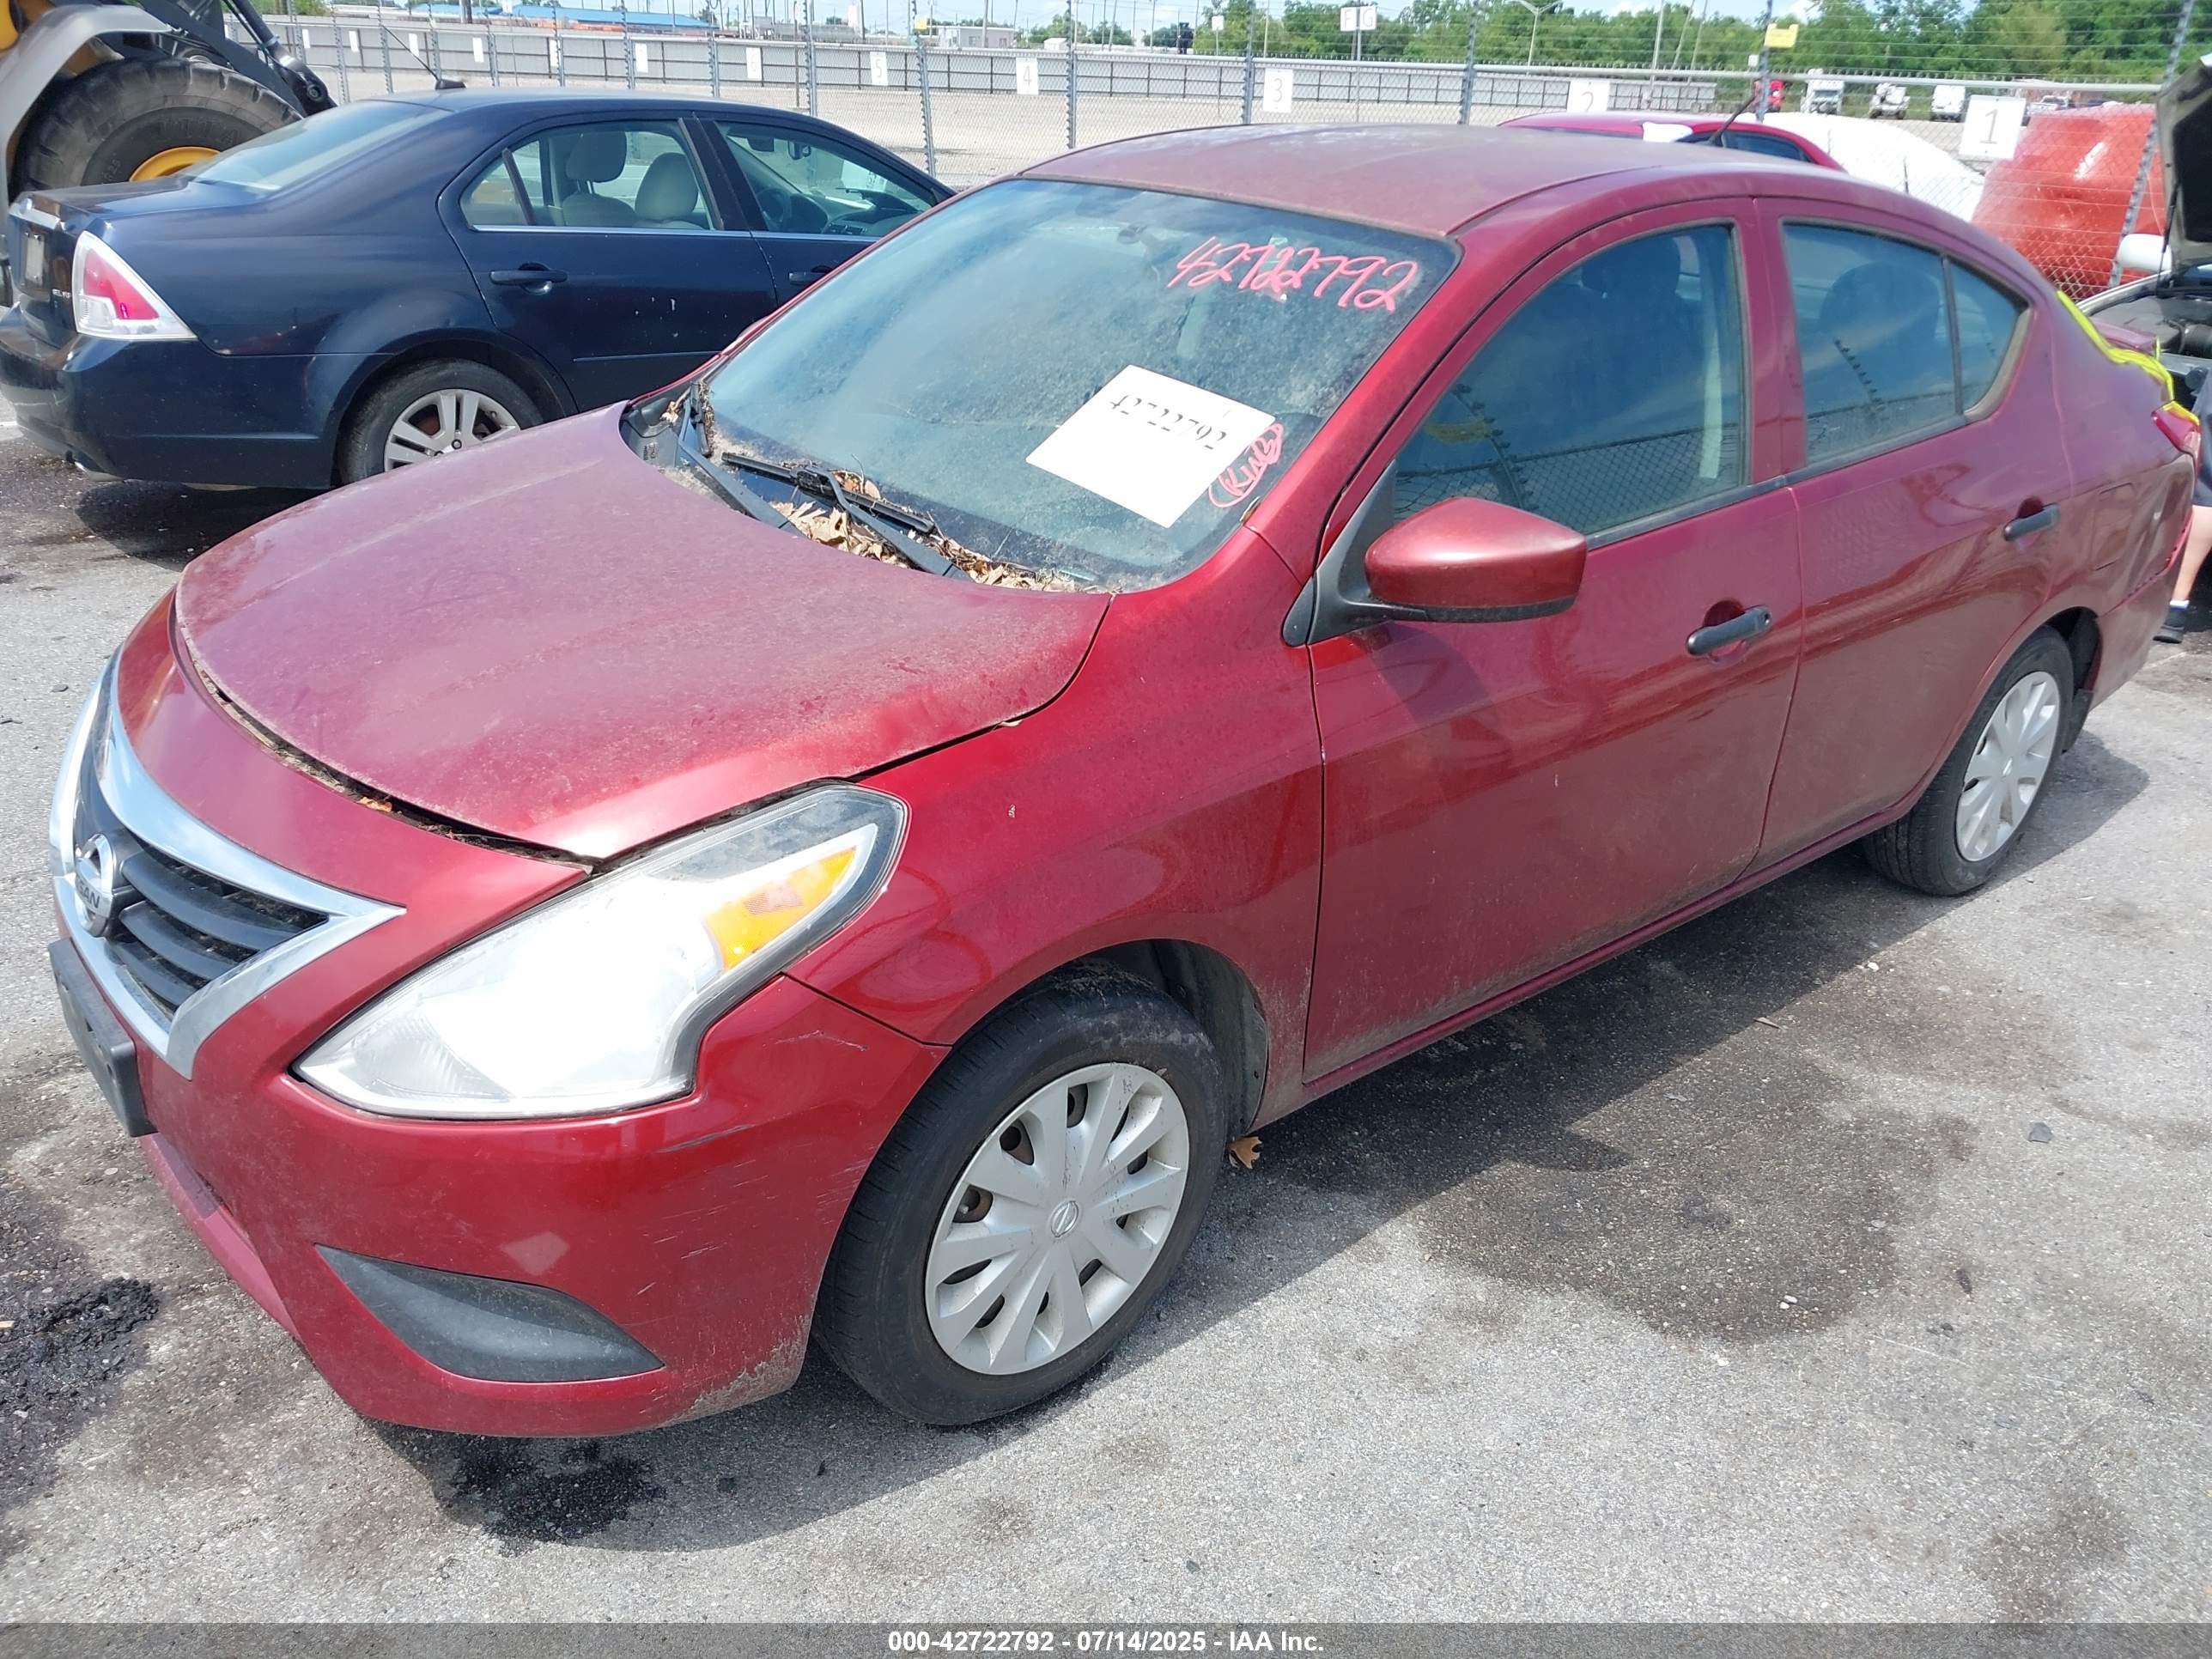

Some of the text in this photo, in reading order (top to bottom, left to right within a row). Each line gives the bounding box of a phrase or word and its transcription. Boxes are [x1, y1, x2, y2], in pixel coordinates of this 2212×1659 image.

[1344, 9, 1353, 28] F
[1363, 8, 1374, 27] G
[1273, 77, 1284, 102] 3
[1979, 108, 1998, 145] 1
[1167, 235, 1419, 312] 42722792
